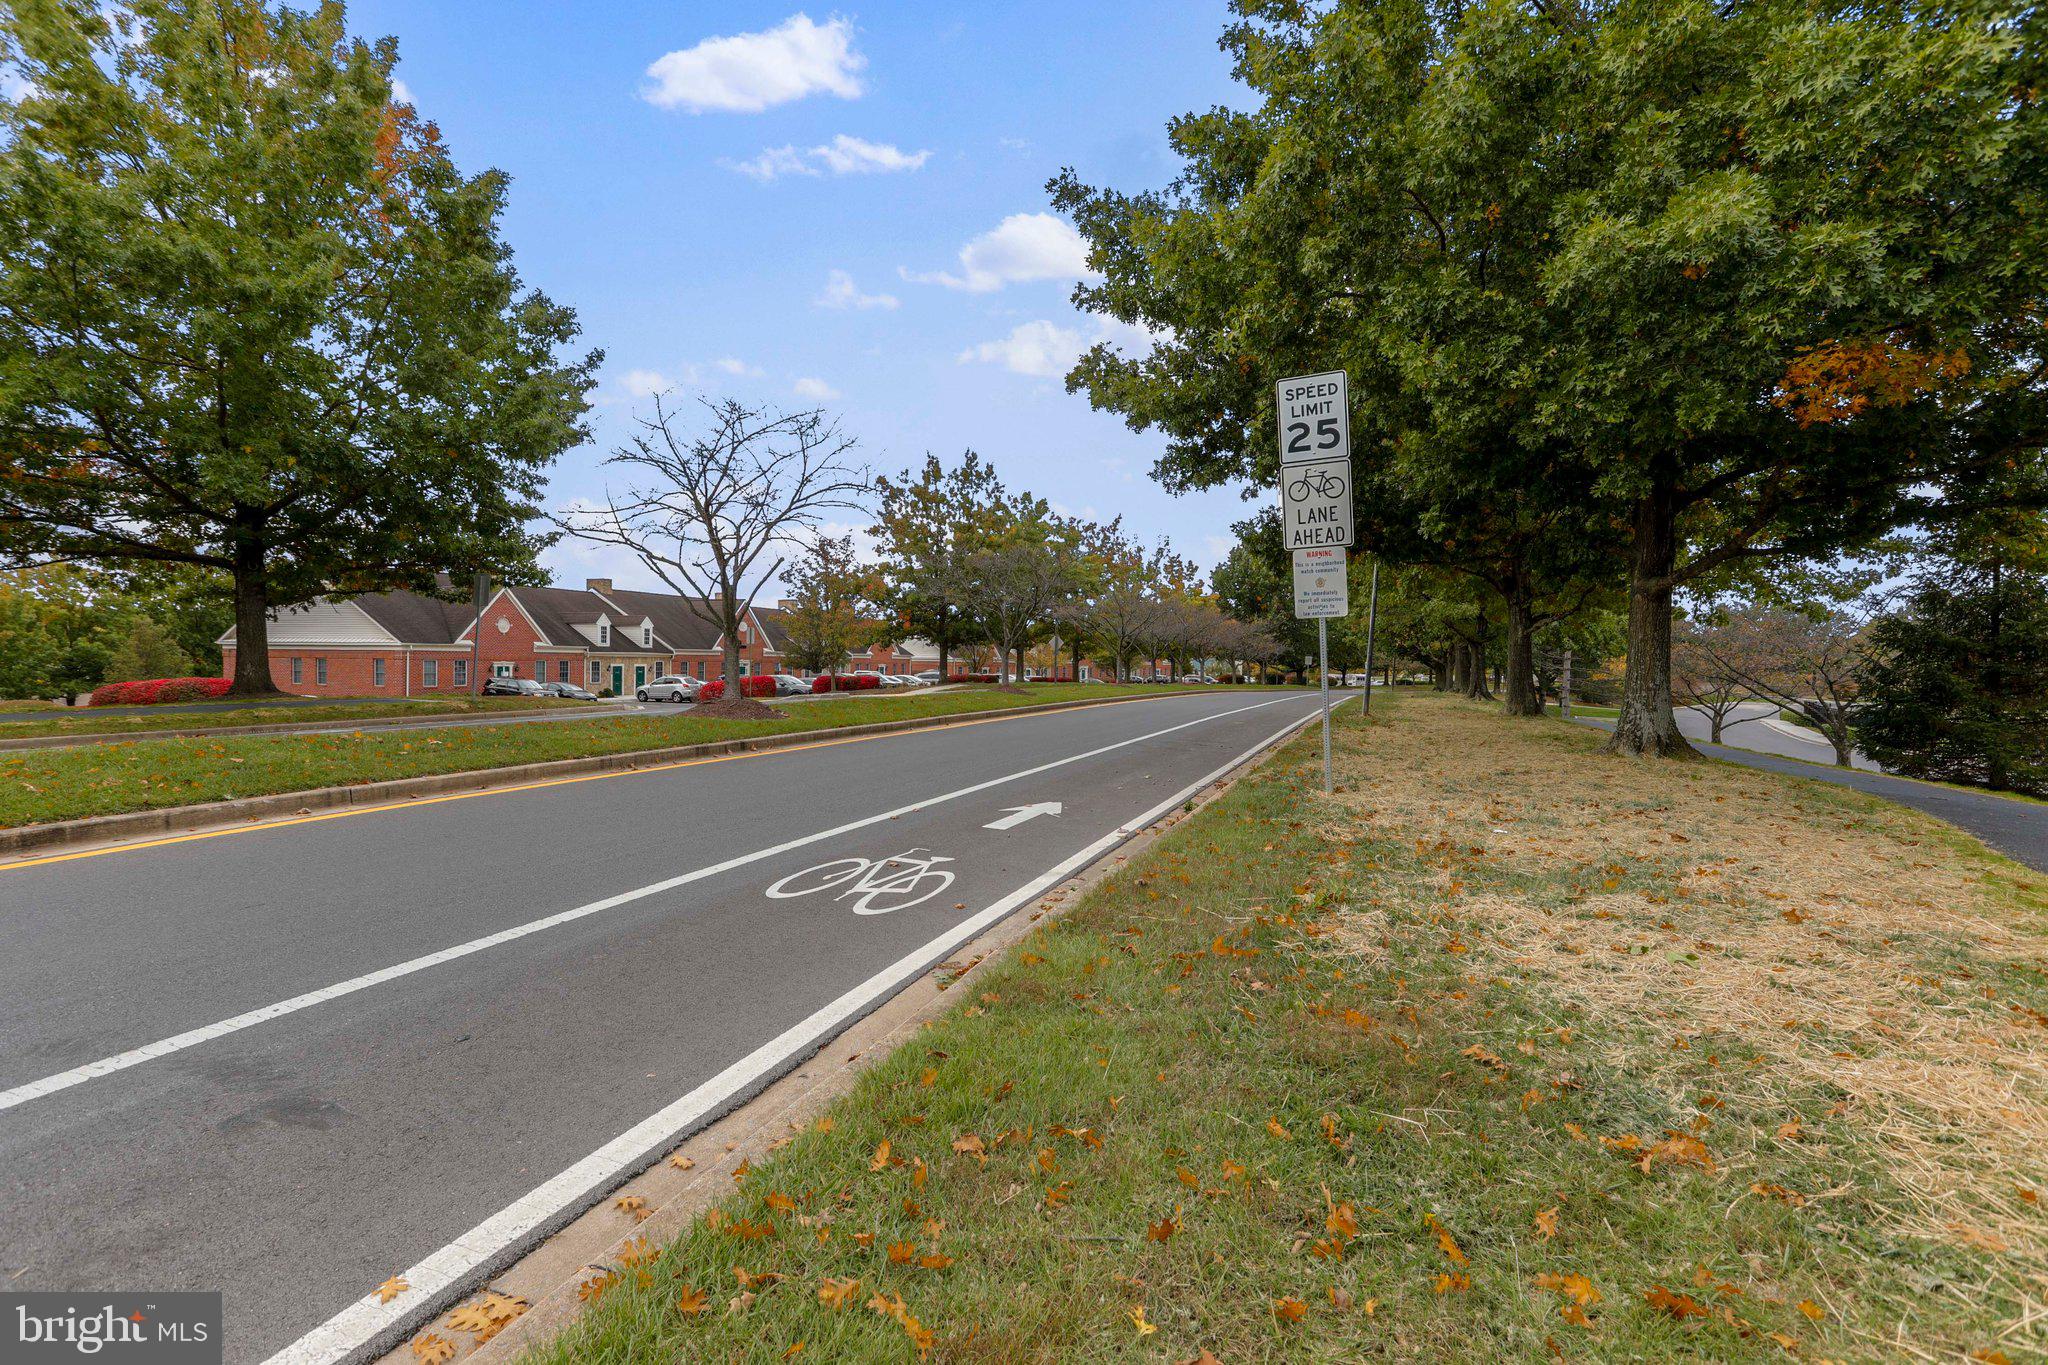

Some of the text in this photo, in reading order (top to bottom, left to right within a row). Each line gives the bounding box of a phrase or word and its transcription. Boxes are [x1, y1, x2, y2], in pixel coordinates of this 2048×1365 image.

[1285, 382, 1338, 401] SPEED
[1291, 401, 1333, 418] LIMIT
[1287, 418, 1341, 453] 25
[1297, 505, 1338, 525] LANE
[1293, 526, 1345, 546] AHEAD
